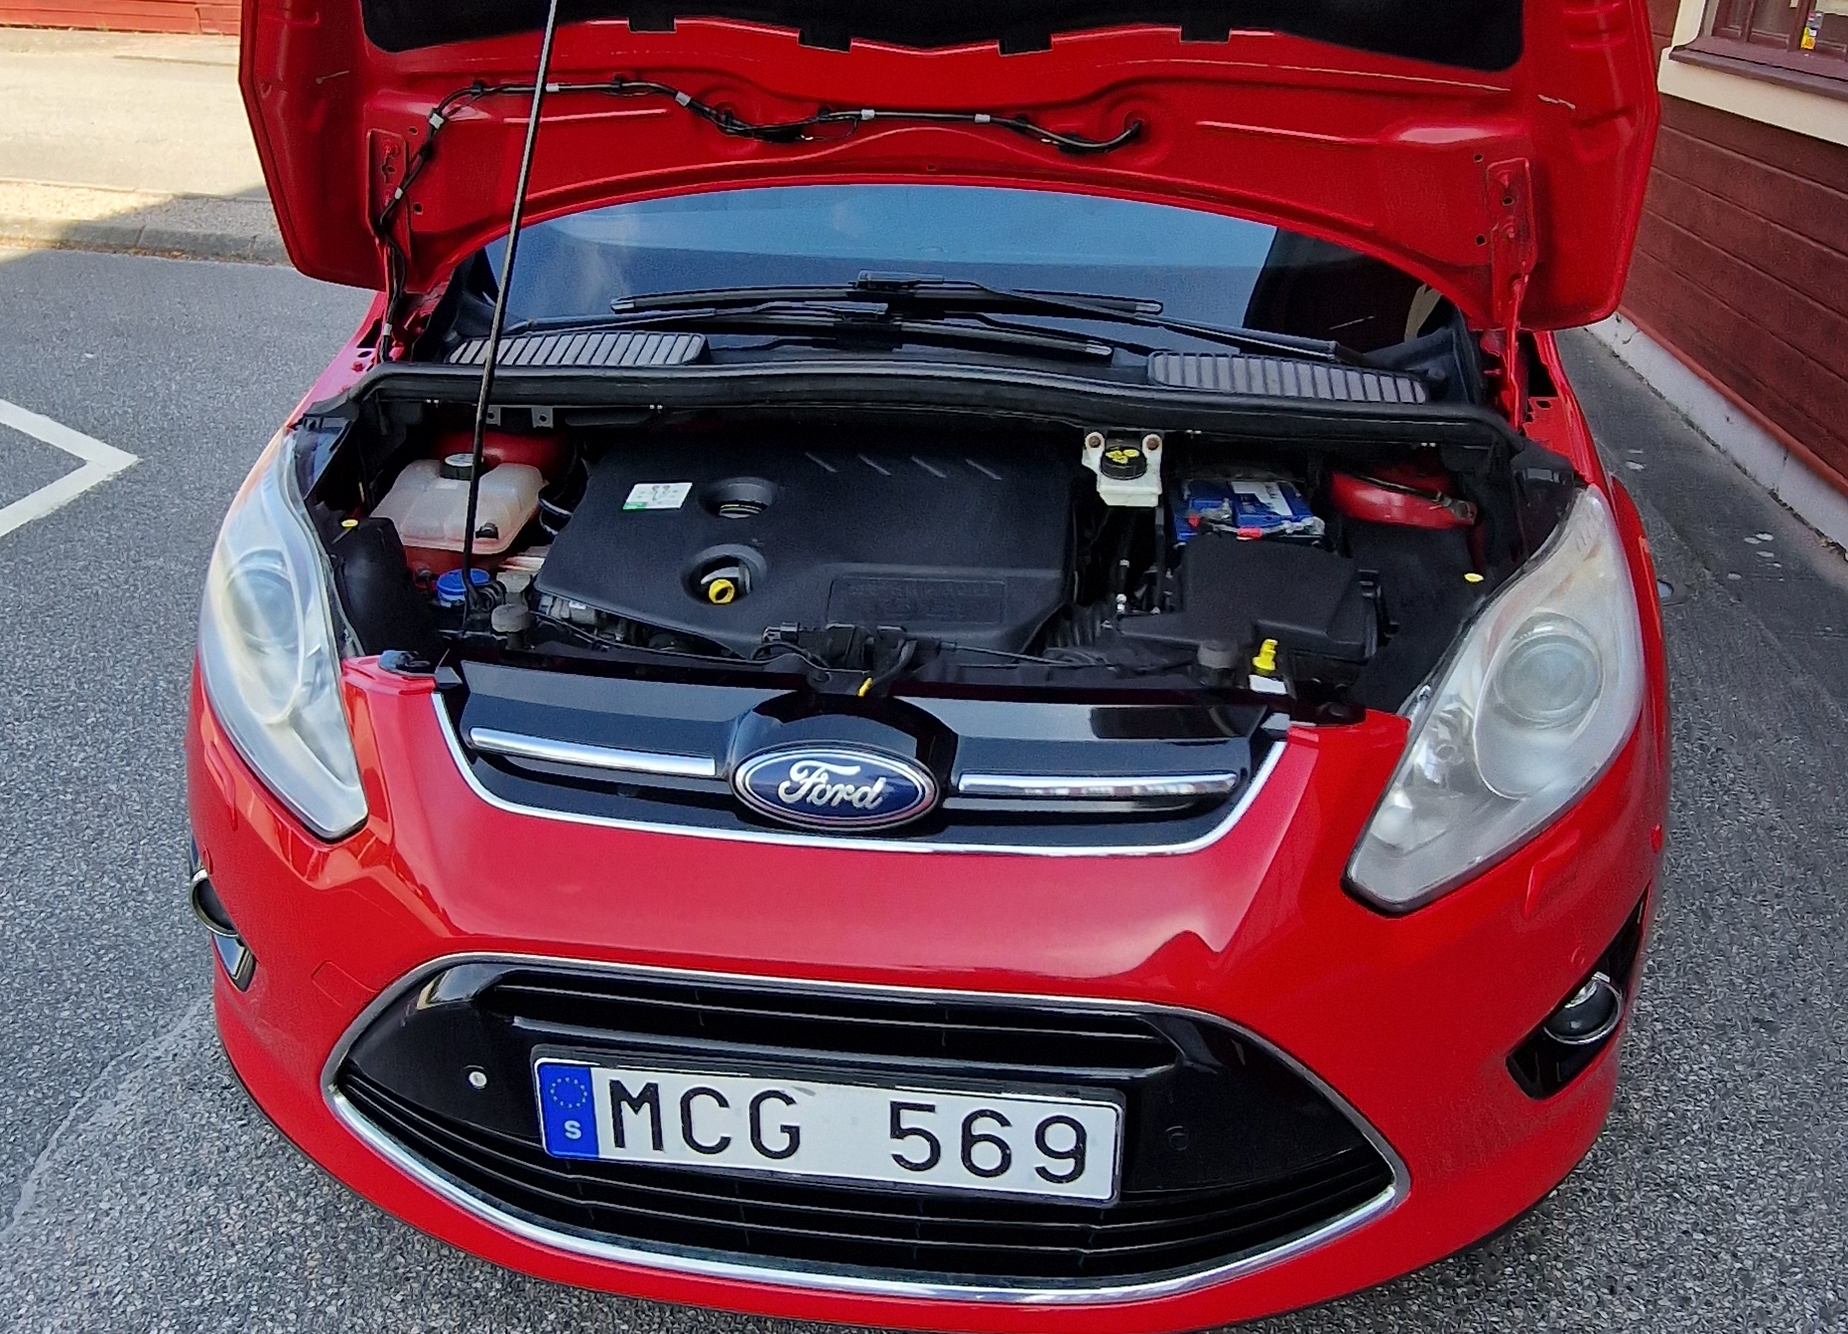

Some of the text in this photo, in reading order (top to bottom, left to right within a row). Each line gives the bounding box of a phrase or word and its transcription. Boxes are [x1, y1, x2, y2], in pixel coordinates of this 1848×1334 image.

[777, 760, 887, 810] Ford
[564, 1120, 582, 1140] S
[608, 1078, 1089, 1186] MCG 569
